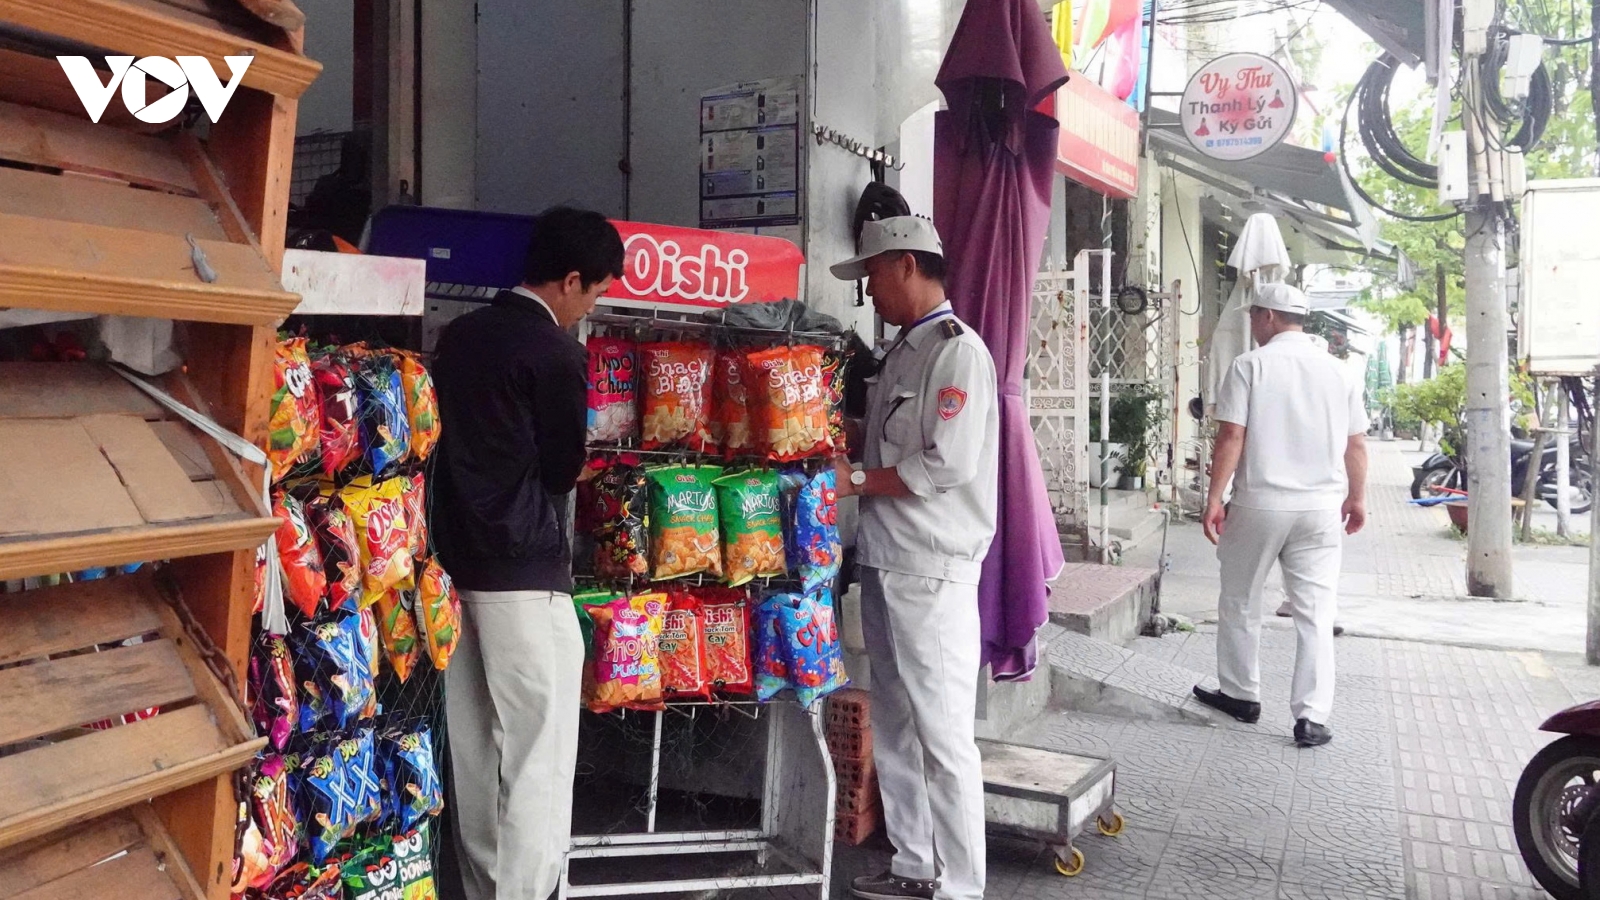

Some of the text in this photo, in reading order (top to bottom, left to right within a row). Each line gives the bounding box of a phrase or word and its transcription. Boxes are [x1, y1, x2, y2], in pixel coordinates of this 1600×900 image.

[1200, 66, 1273, 99] Vy Thư
[1189, 95, 1266, 115] Thanh Lý
[1243, 115, 1272, 131] Gửi
[621, 232, 749, 303] Oishi
[762, 358, 785, 369] Oishi
[704, 609, 734, 625] ishi
[658, 641, 677, 653] Cay
[707, 635, 726, 645] Cay
